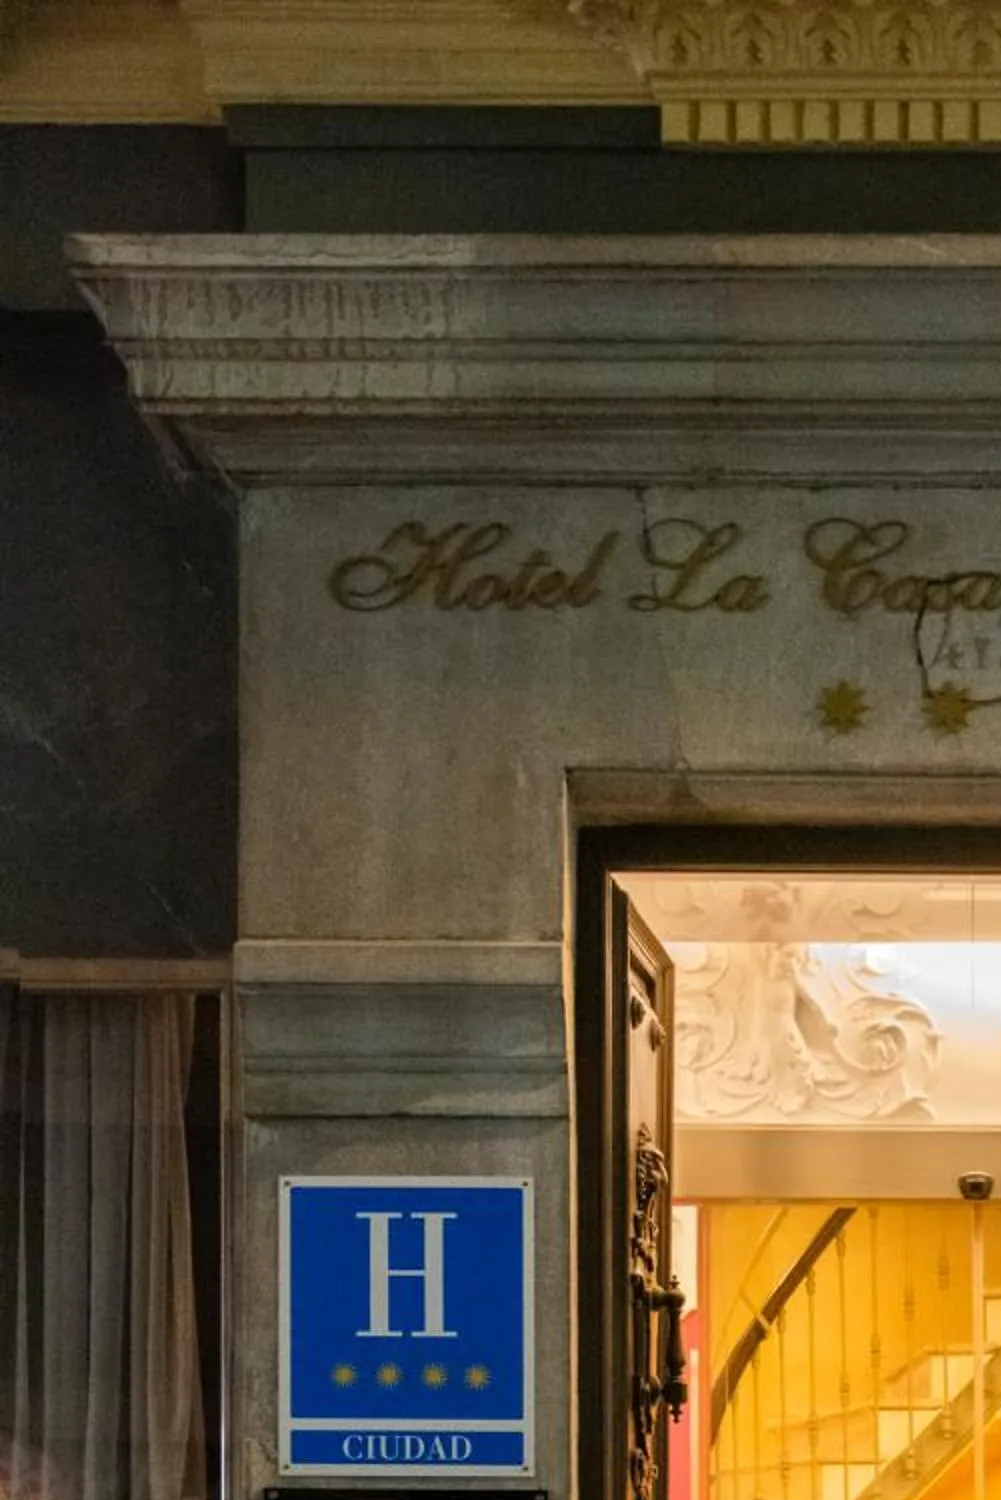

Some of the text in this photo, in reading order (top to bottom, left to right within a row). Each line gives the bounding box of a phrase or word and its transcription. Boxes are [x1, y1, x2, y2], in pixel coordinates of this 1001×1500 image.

[328, 521, 620, 612] Hotel
[628, 518, 771, 613] La
[355, 1211, 458, 1337] H
[342, 1434, 472, 1461] CIUDAD
